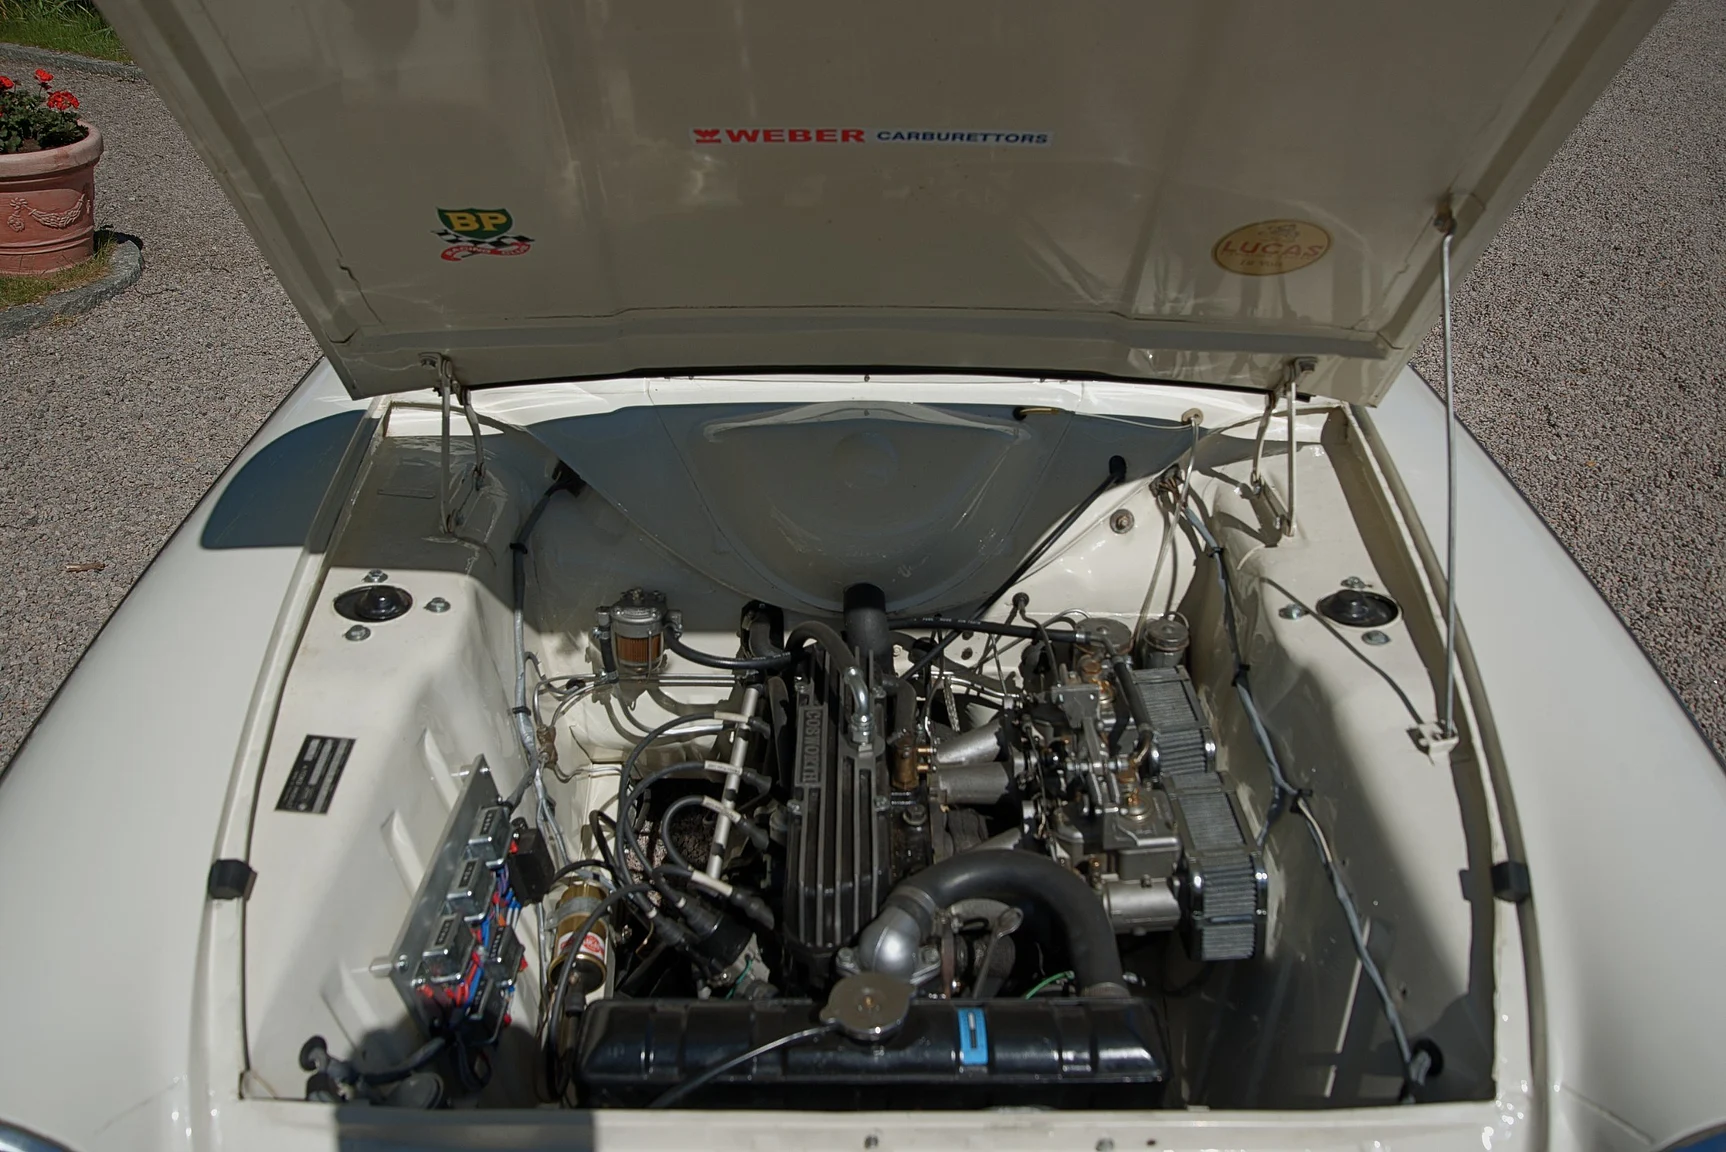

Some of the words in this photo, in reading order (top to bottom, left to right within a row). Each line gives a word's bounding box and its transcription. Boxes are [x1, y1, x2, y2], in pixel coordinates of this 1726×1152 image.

[726, 128, 865, 143] WEBER
[876, 130, 1048, 145] CARBURETTORS
[445, 212, 507, 231] BP
[1220, 240, 1323, 256] LUCAS
[802, 710, 821, 784] COSWORTH
